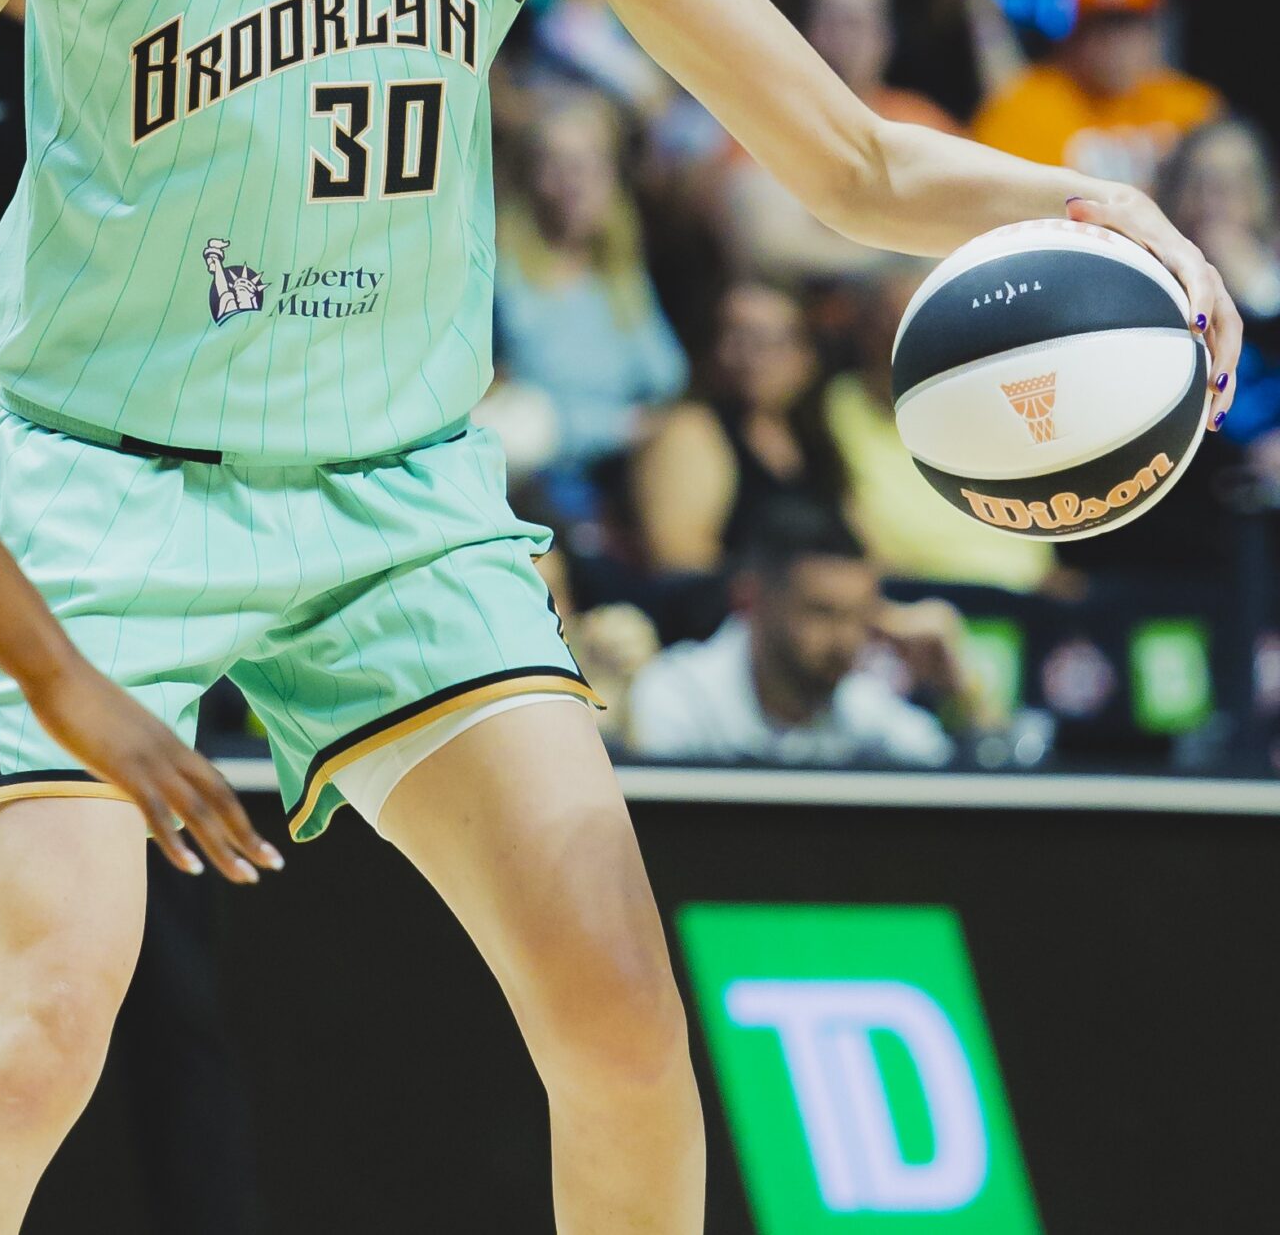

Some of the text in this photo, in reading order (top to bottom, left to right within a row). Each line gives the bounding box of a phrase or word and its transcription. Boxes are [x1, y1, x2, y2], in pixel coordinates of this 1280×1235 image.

[307, 79, 446, 202] 30
[268, 293, 379, 319] Mutual
[280, 266, 384, 299] Liberty
[960, 452, 1174, 530] Wilson
[724, 978, 988, 1215] TD
